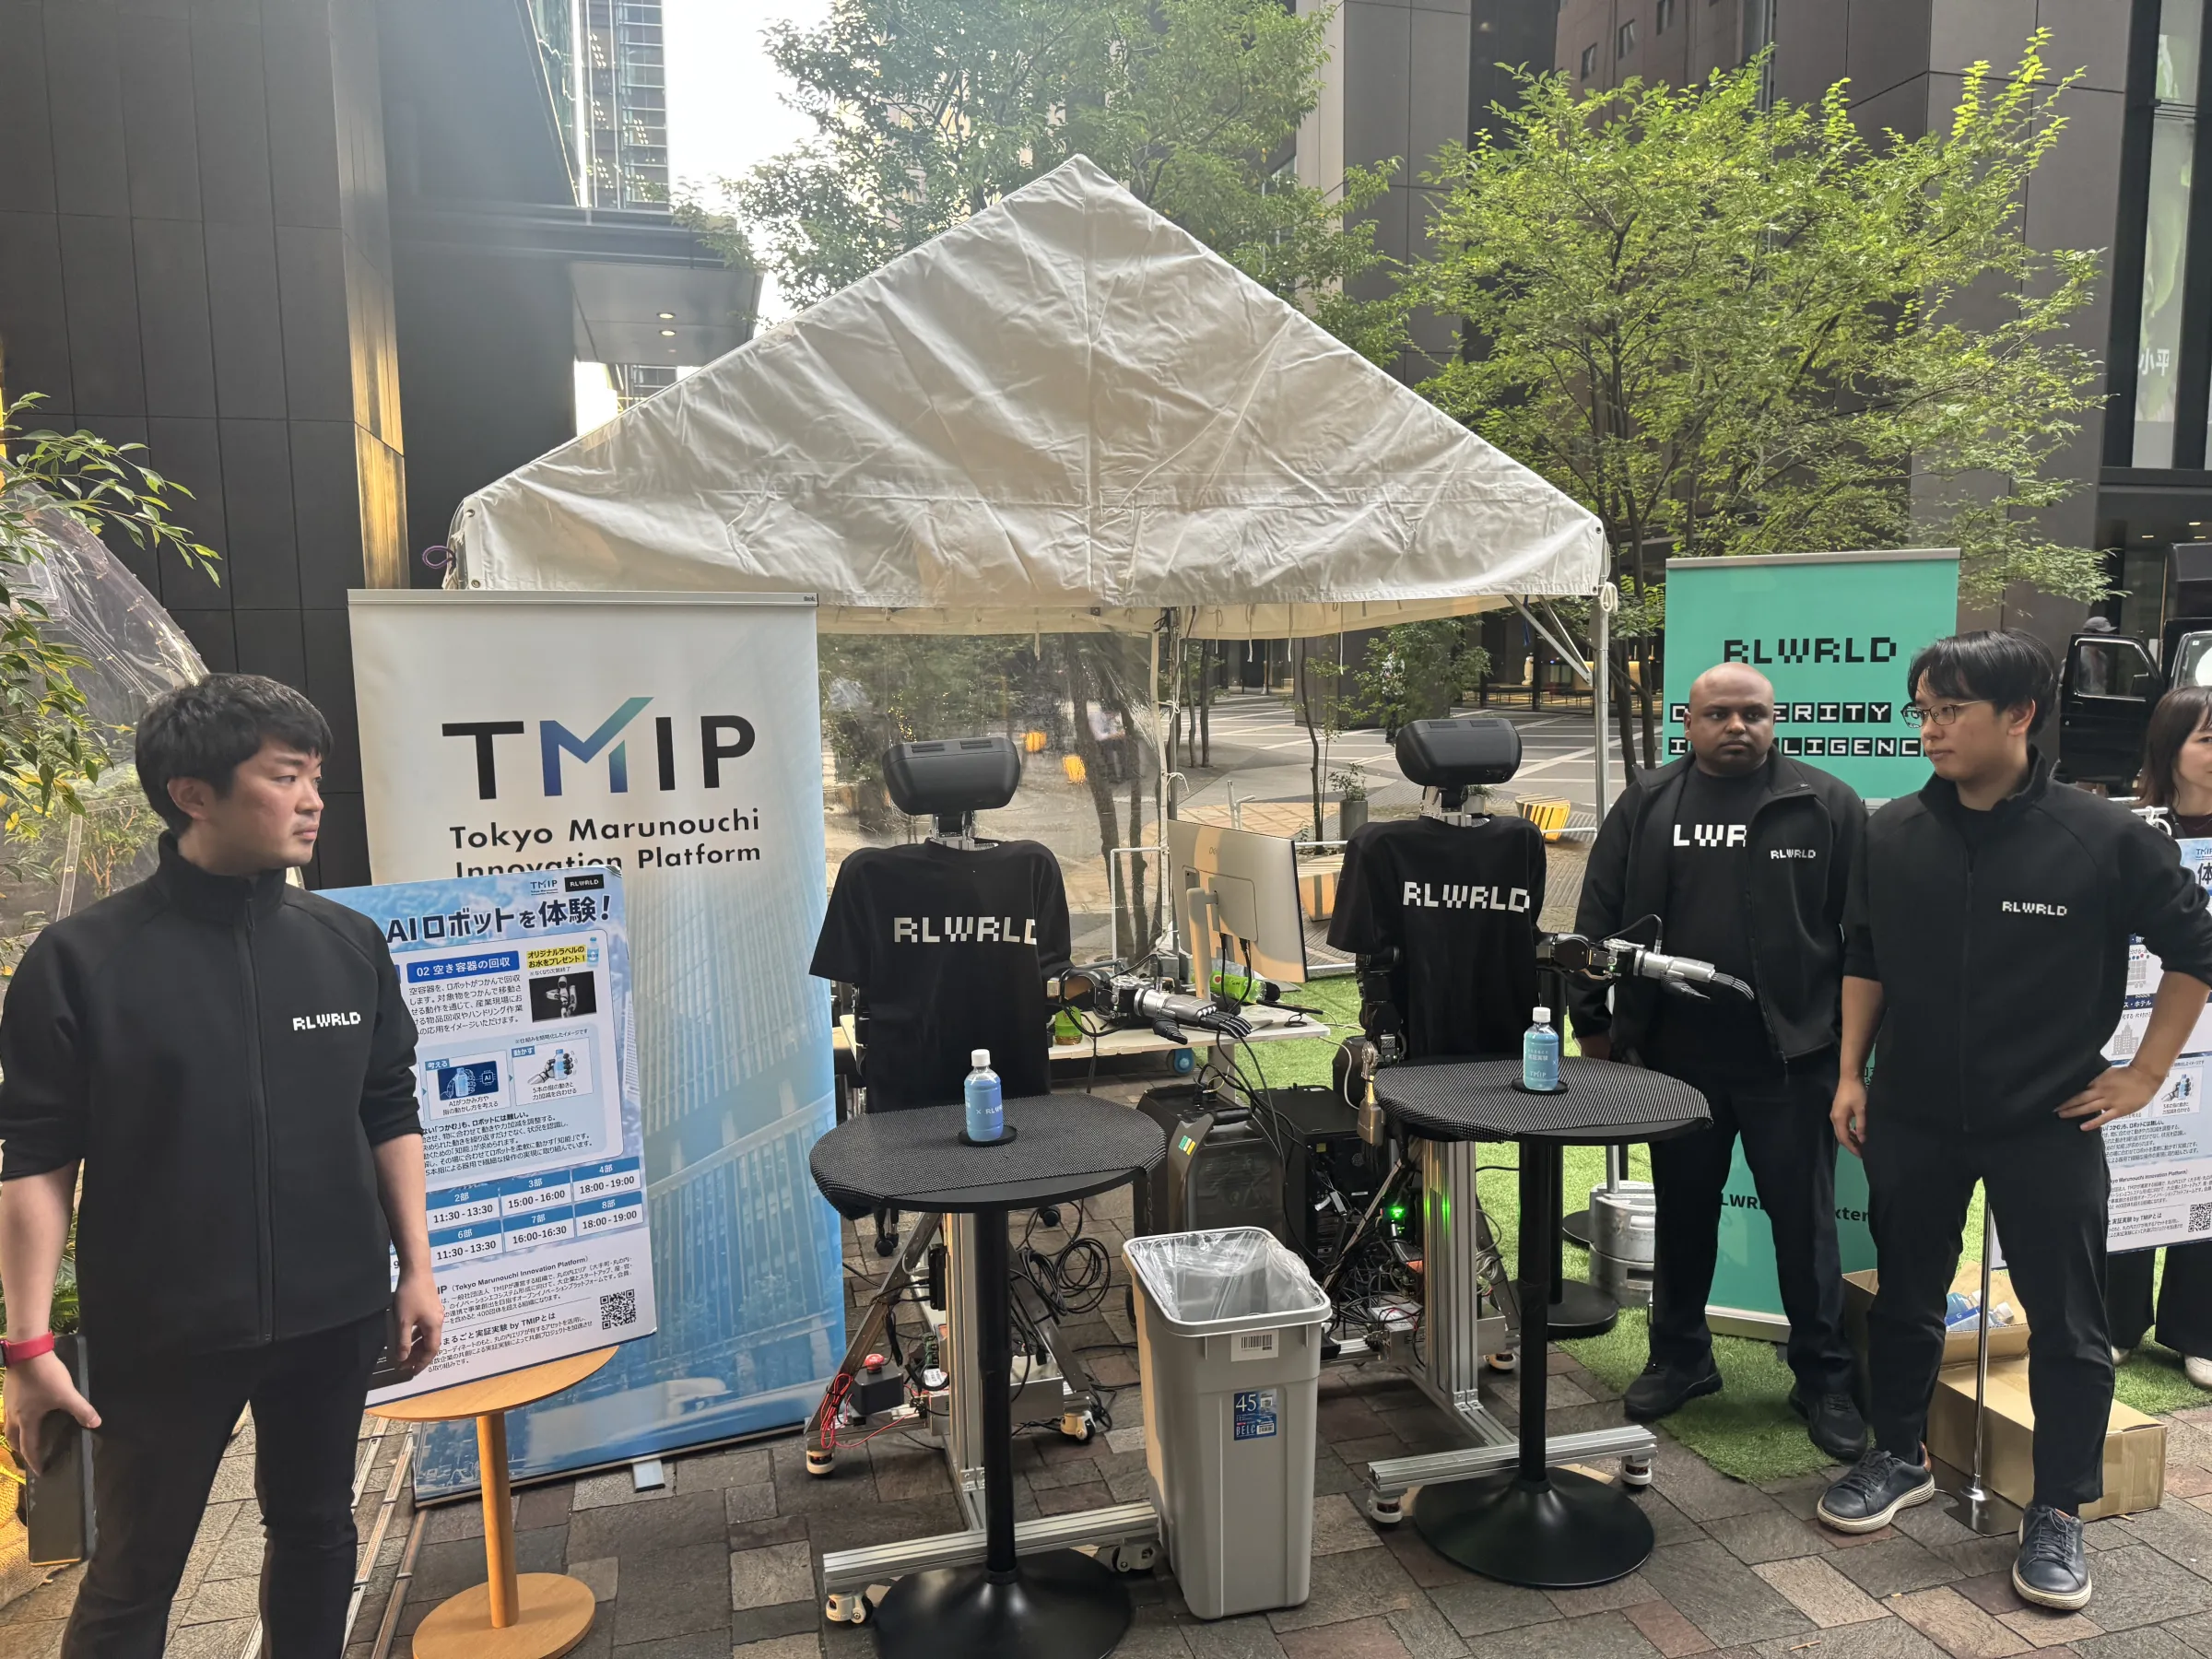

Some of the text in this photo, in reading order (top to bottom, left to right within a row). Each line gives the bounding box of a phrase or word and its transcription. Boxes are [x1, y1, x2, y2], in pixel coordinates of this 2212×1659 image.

[1724, 637, 1897, 665] RLWRLD
[1672, 704, 1889, 721] DERITY
[441, 696, 756, 800] TMIP
[1670, 738, 1919, 755] ILIGENC
[450, 807, 759, 853] Tokyo Marunouchi
[1673, 824, 1747, 847] LWR
[638, 843, 761, 869] Platform
[1771, 849, 1817, 860] RLWRLD
[530, 879, 558, 889] TMIP
[570, 878, 599, 888] RLWRLD
[1403, 881, 1530, 913] RLWRLD
[2002, 900, 2068, 917] RLWRLD
[527, 945, 584, 959] オリジナルラベルの
[417, 957, 511, 977] 02 空き容器の回収
[293, 1011, 361, 1031] RLWRLD
[418, 1016, 519, 1035] の応用をイメージいただけます。
[512, 1047, 534, 1057] 動かす
[427, 1060, 448, 1070] 考える
[599, 1163, 613, 1173] 4部
[528, 1178, 543, 1188] 3部
[580, 1182, 605, 1194] 18:00
[611, 1175, 635, 1187] 19:00
[454, 1192, 469, 1203] 2部
[508, 1197, 534, 1208] 15:00
[540, 1190, 565, 1202] 16:00
[602, 1198, 616, 1209] 8部
[433, 1210, 460, 1224] 11:30
[467, 1204, 493, 1217] 13:30
[531, 1213, 546, 1224] 7部
[582, 1218, 606, 1230] 18:00
[613, 1210, 638, 1222] 19:00
[458, 1228, 472, 1239] 6部
[437, 1248, 464, 1261] 11:30
[471, 1241, 497, 1253] 13:30
[477, 1272, 519, 1286] Marunouchi
[520, 1264, 556, 1277] Innovation
[522, 1312, 556, 1327] TMIPとは
[1236, 1394, 1257, 1412] 45
